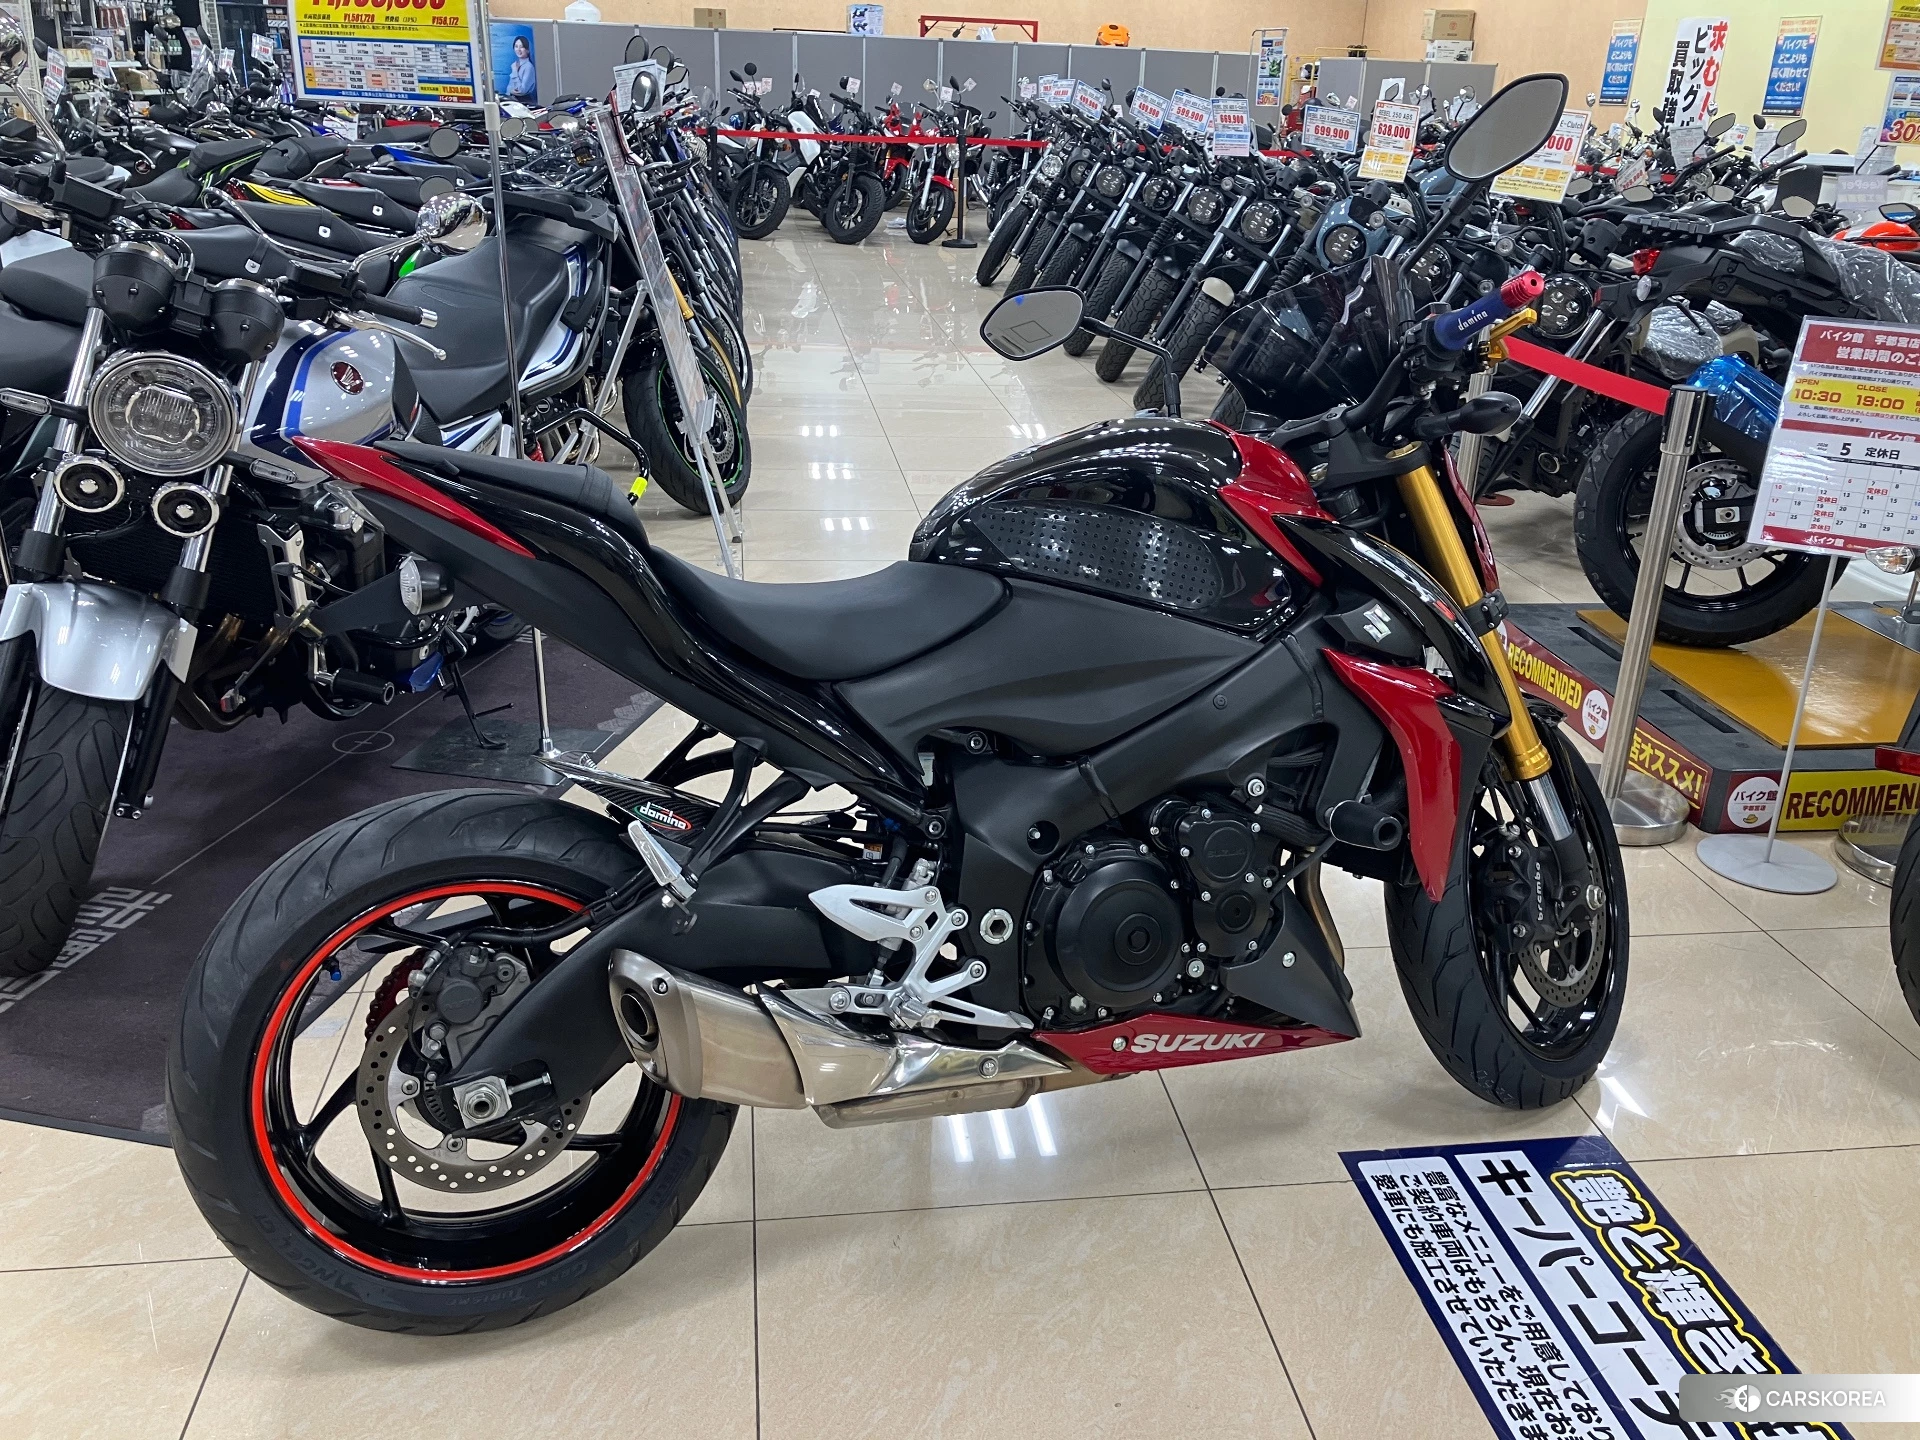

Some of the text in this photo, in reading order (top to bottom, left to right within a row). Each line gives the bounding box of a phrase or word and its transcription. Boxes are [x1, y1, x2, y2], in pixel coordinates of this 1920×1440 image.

[1782, 38, 1809, 50] バイクを
[1777, 52, 1808, 64] どこよりも
[1315, 124, 1350, 141] 699,900
[1378, 122, 1411, 140] 638,000
[1820, 329, 1920, 349] バイク館 宇都宮店
[1836, 345, 1920, 366] 営業時間のご
[1795, 378, 1820, 386] OPEN
[1856, 384, 1889, 394] CLOSE
[1794, 388, 1842, 403] 10:30
[1856, 394, 1905, 410] 19:00
[1840, 442, 1901, 461] 5 定休日
[1817, 495, 1838, 504] 定休日
[1866, 487, 1889, 496] 定休日
[1813, 509, 1835, 518] 定休日
[1810, 523, 1831, 532] 定休日
[1507, 642, 1583, 711] RECOMMENDED
[1734, 790, 1779, 802] バイク館
[1785, 782, 1920, 820] RECOMMEN
[1534, 861, 1545, 922] brembo
[1131, 1032, 1266, 1054] SUZUKI
[1400, 1174, 1585, 1440] ご契約車両はもちろん、現在お
